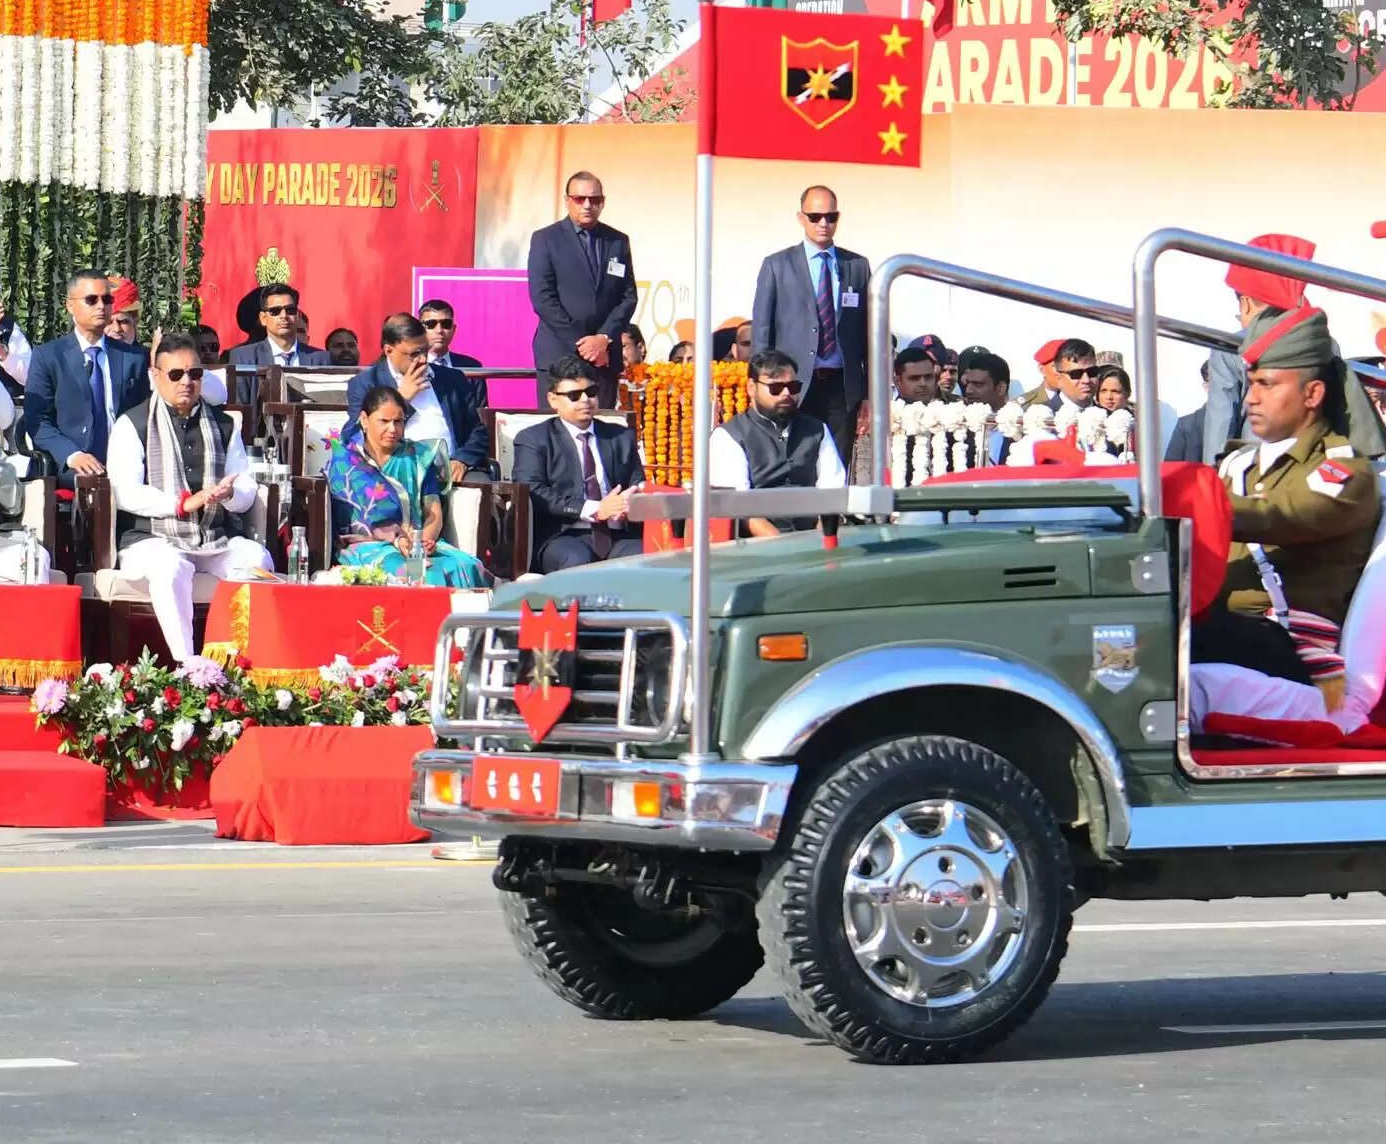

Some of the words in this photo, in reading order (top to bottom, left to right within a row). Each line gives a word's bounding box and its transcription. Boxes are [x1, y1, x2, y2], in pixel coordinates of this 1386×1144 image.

[922, 37, 1093, 114] ARADE
[1103, 35, 1235, 110] 2026
[220, 163, 259, 205] DAY
[263, 163, 341, 205] PARADE
[345, 165, 397, 208] 2026
